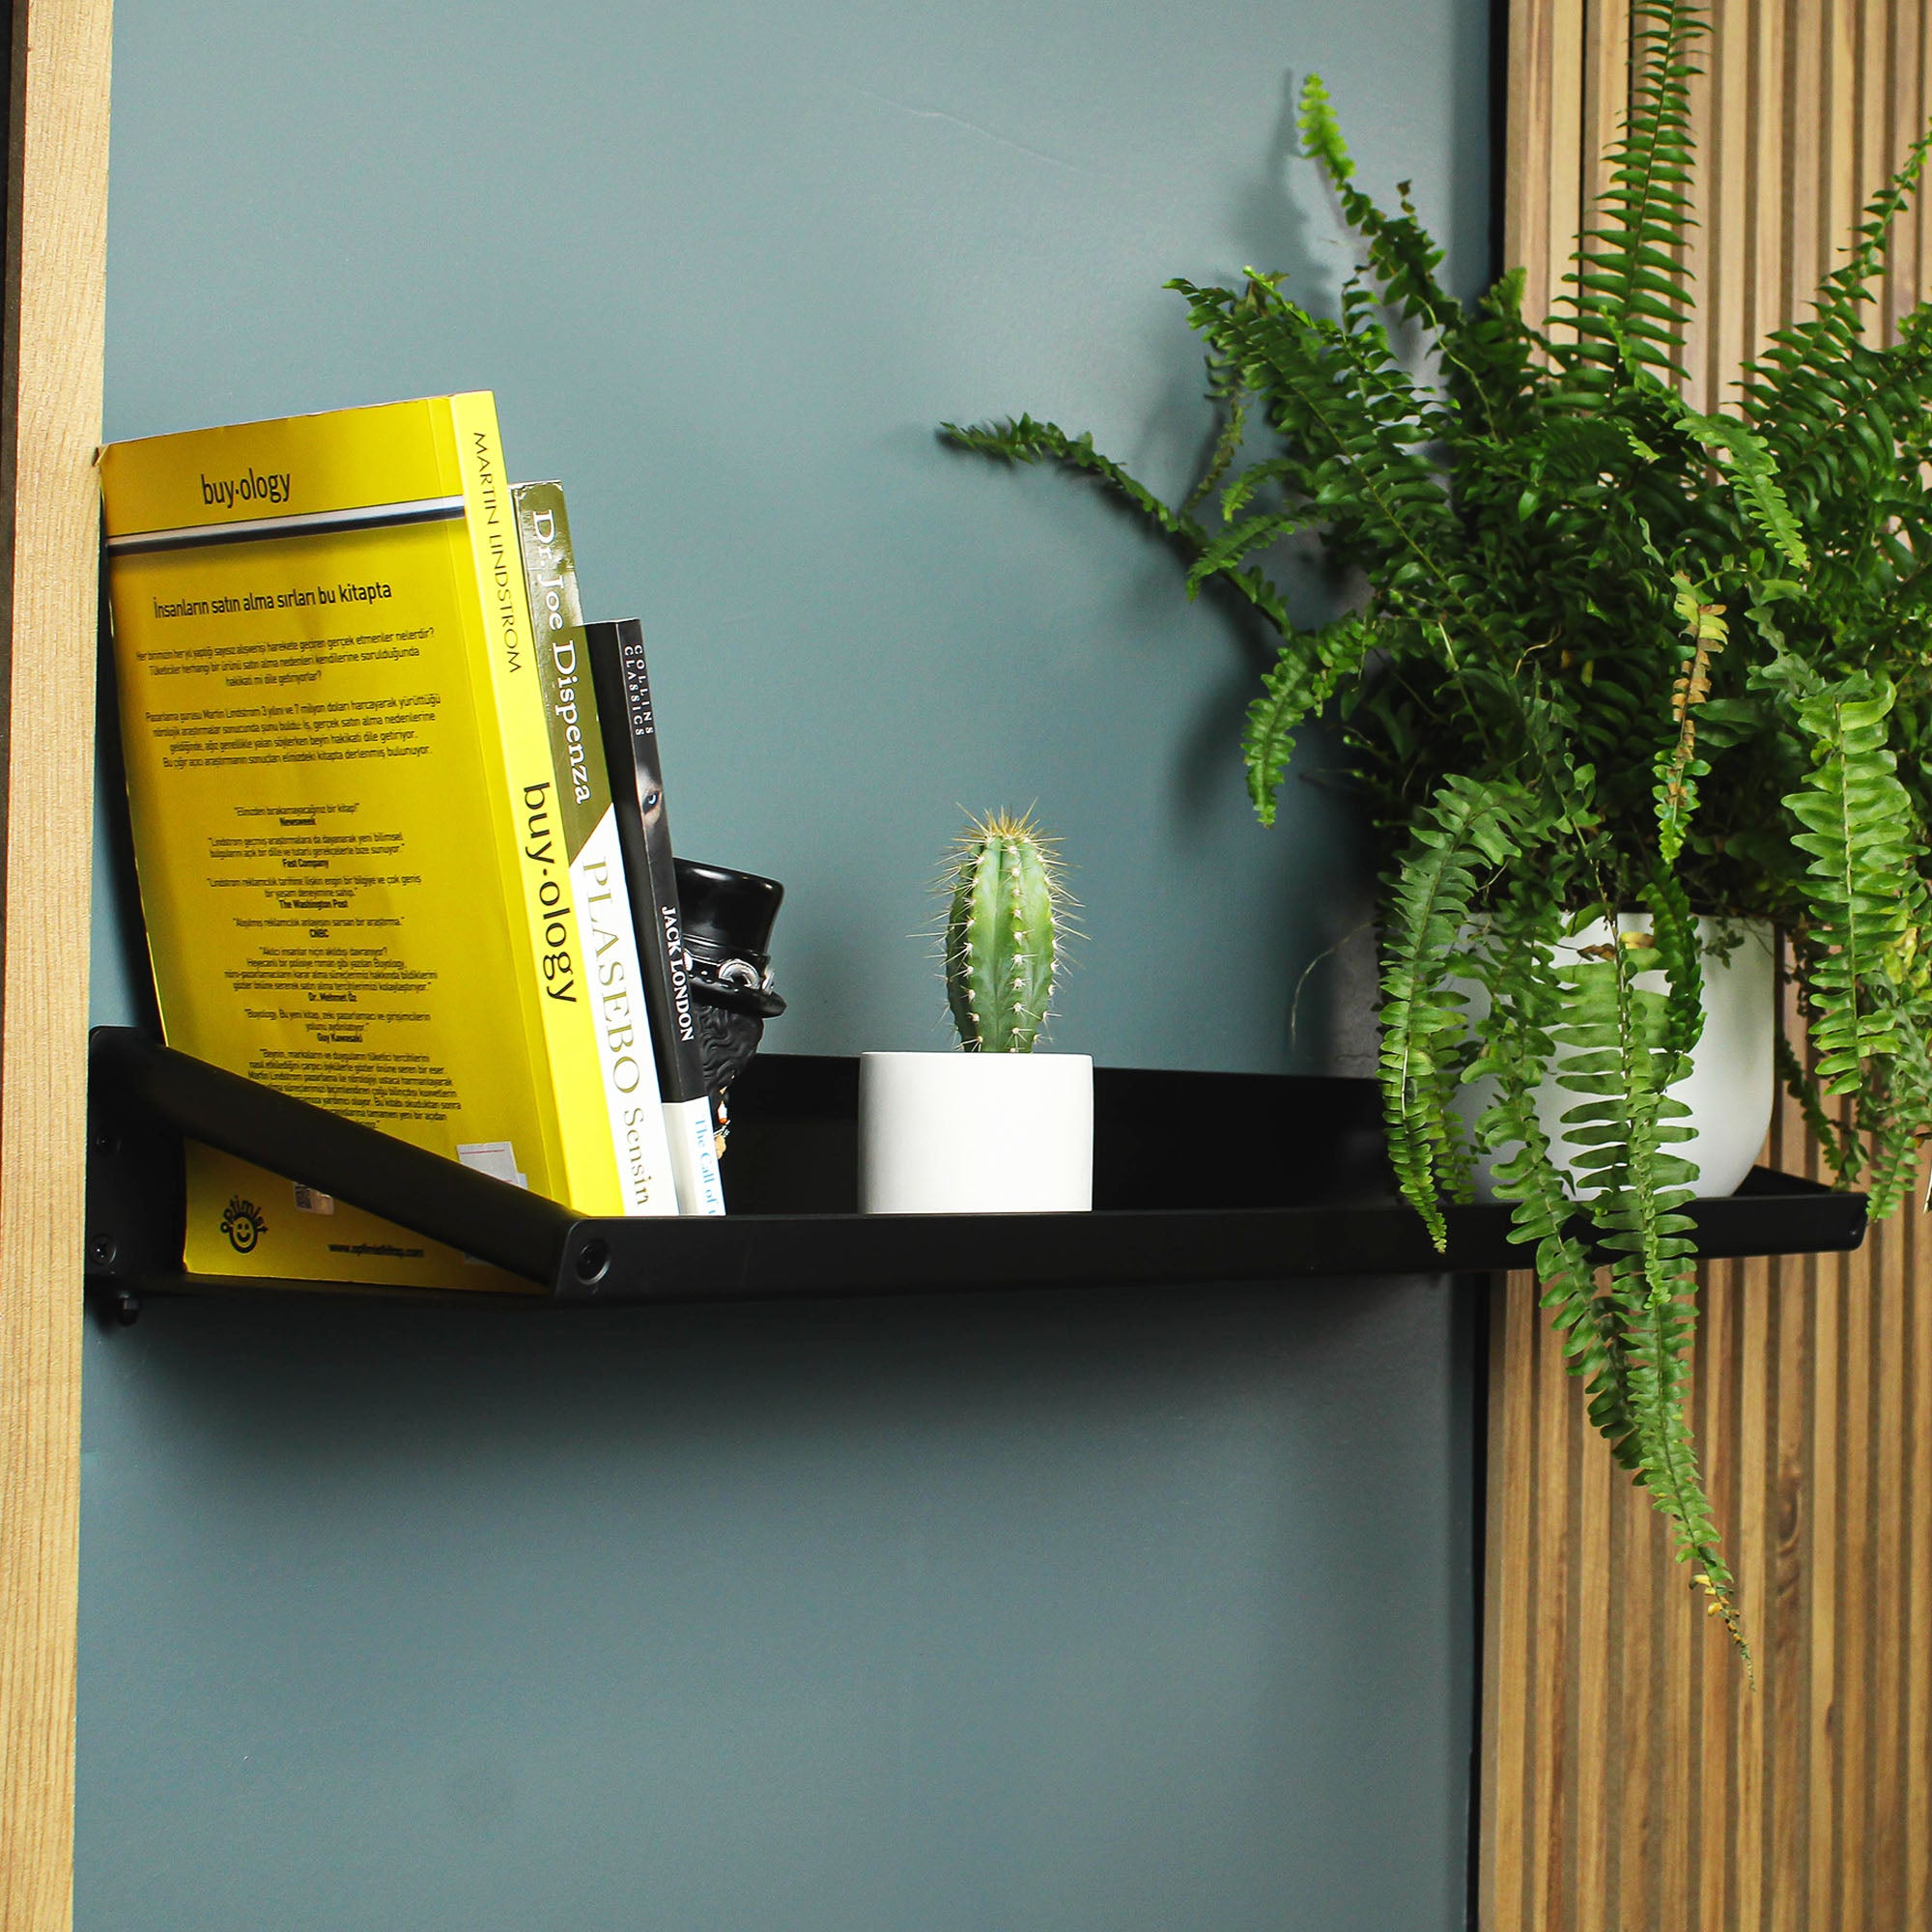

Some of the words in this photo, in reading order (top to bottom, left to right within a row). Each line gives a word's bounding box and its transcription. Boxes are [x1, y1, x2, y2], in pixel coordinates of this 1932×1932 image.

[473, 432, 499, 526] MARTIN
[490, 535, 522, 673] LINDSTROM
[531, 509, 556, 567] Dr.
[153, 596, 210, 618] İnsanların
[212, 595, 242, 613] satın
[243, 592, 275, 611] alma
[277, 588, 317, 609] sırları
[317, 585, 336, 605] bu
[338, 582, 392, 605] kitapta
[537, 575, 564, 631] Joe
[552, 639, 592, 805] Dispenza
[624, 645, 645, 736] CLASSICS
[634, 644, 654, 734] COLLINS
[661, 905, 683, 956] JACK
[582, 856, 640, 1094] PLASEBO
[623, 1107, 653, 1206] Sensin
[668, 958, 696, 1043] LONDON
[700, 1152, 716, 1183] Call
[705, 1189, 719, 1205] of
